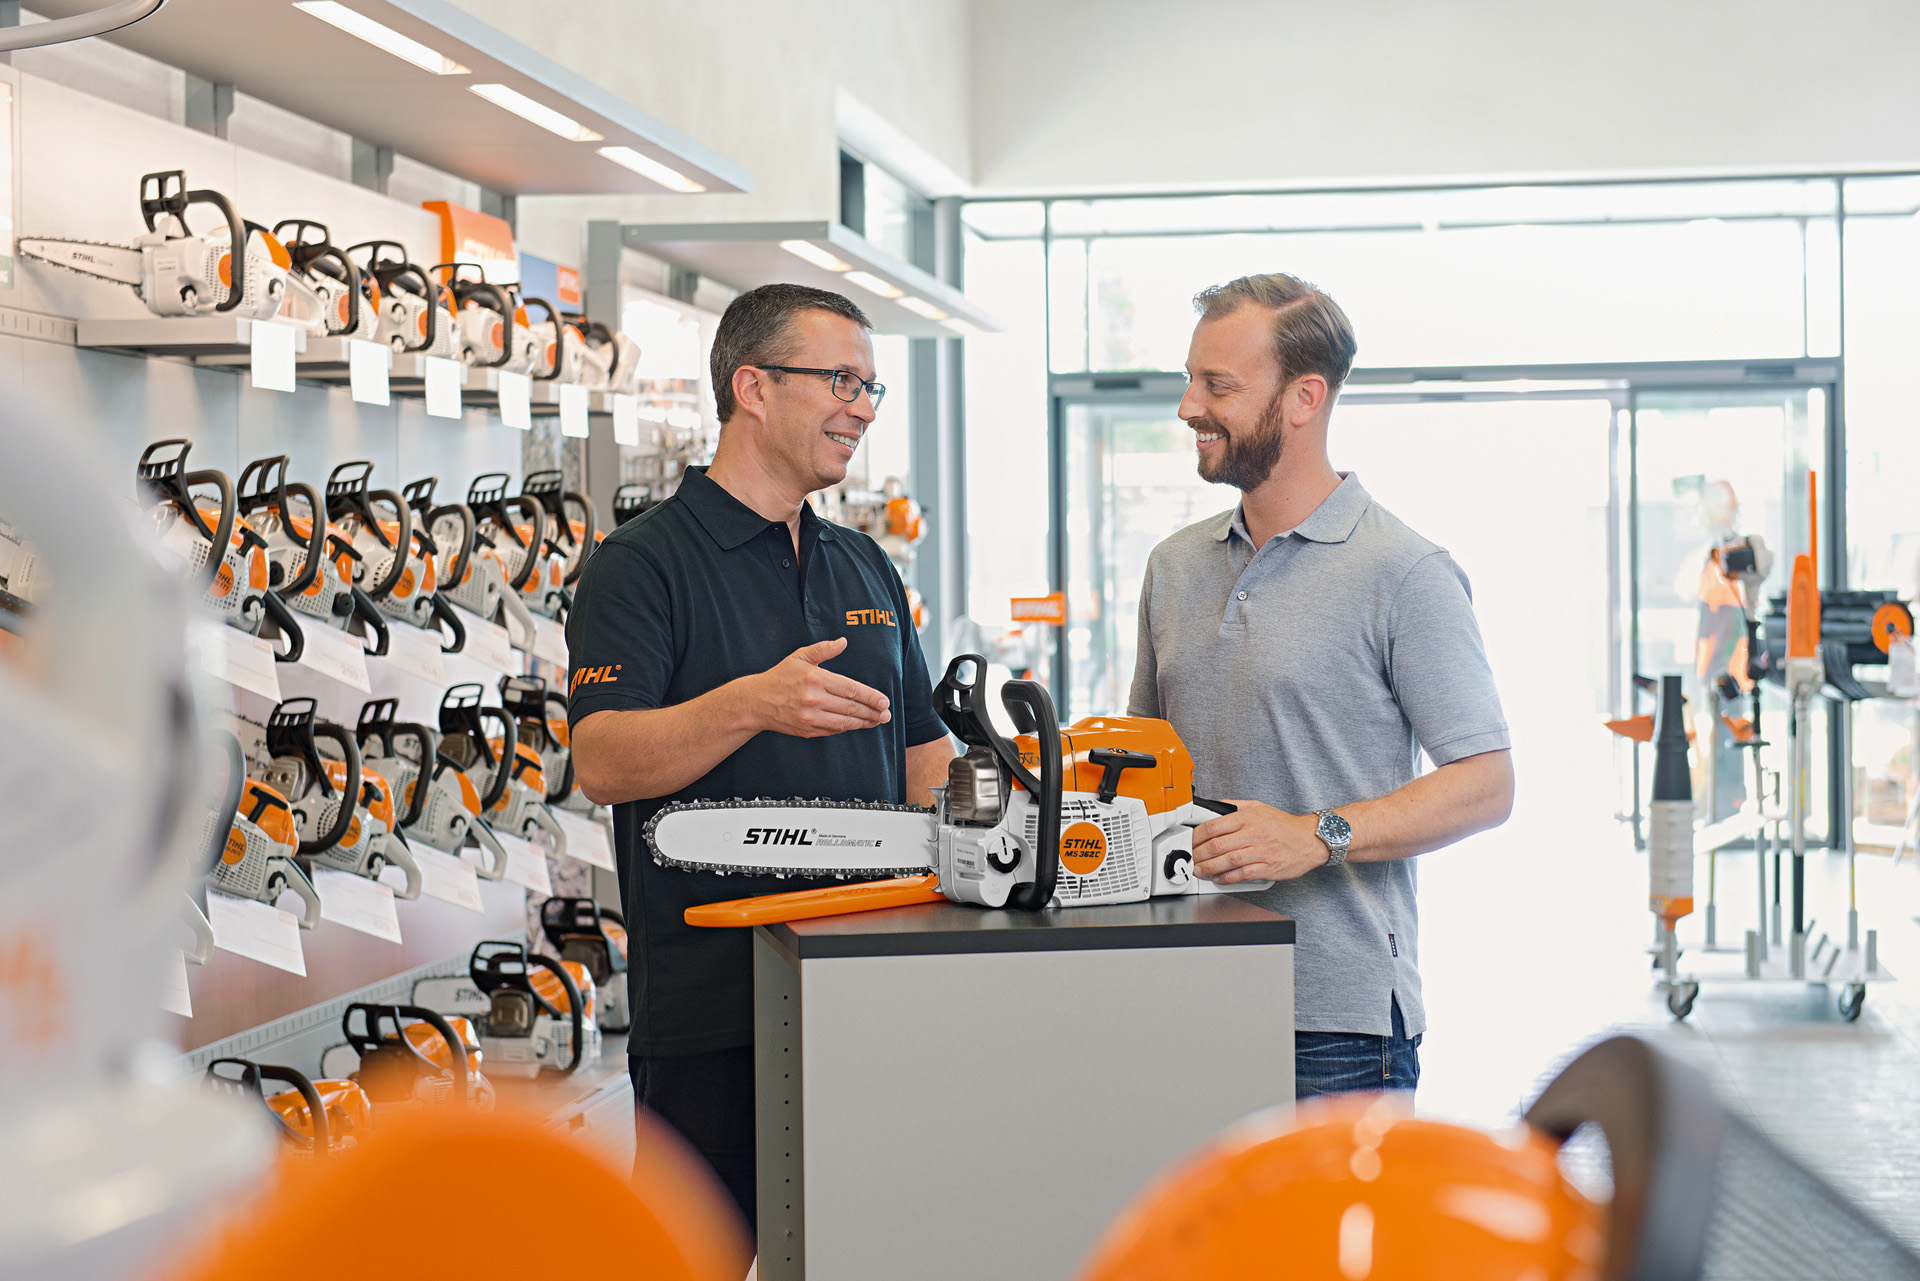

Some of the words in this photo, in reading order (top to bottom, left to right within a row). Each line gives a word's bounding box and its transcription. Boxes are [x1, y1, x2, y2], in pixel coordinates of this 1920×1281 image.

[845, 608, 896, 627] STIHL
[743, 828, 813, 846] STIHL
[874, 839, 883, 848] E
[1063, 838, 1102, 850] STIHL
[1064, 850, 1078, 858] MS
